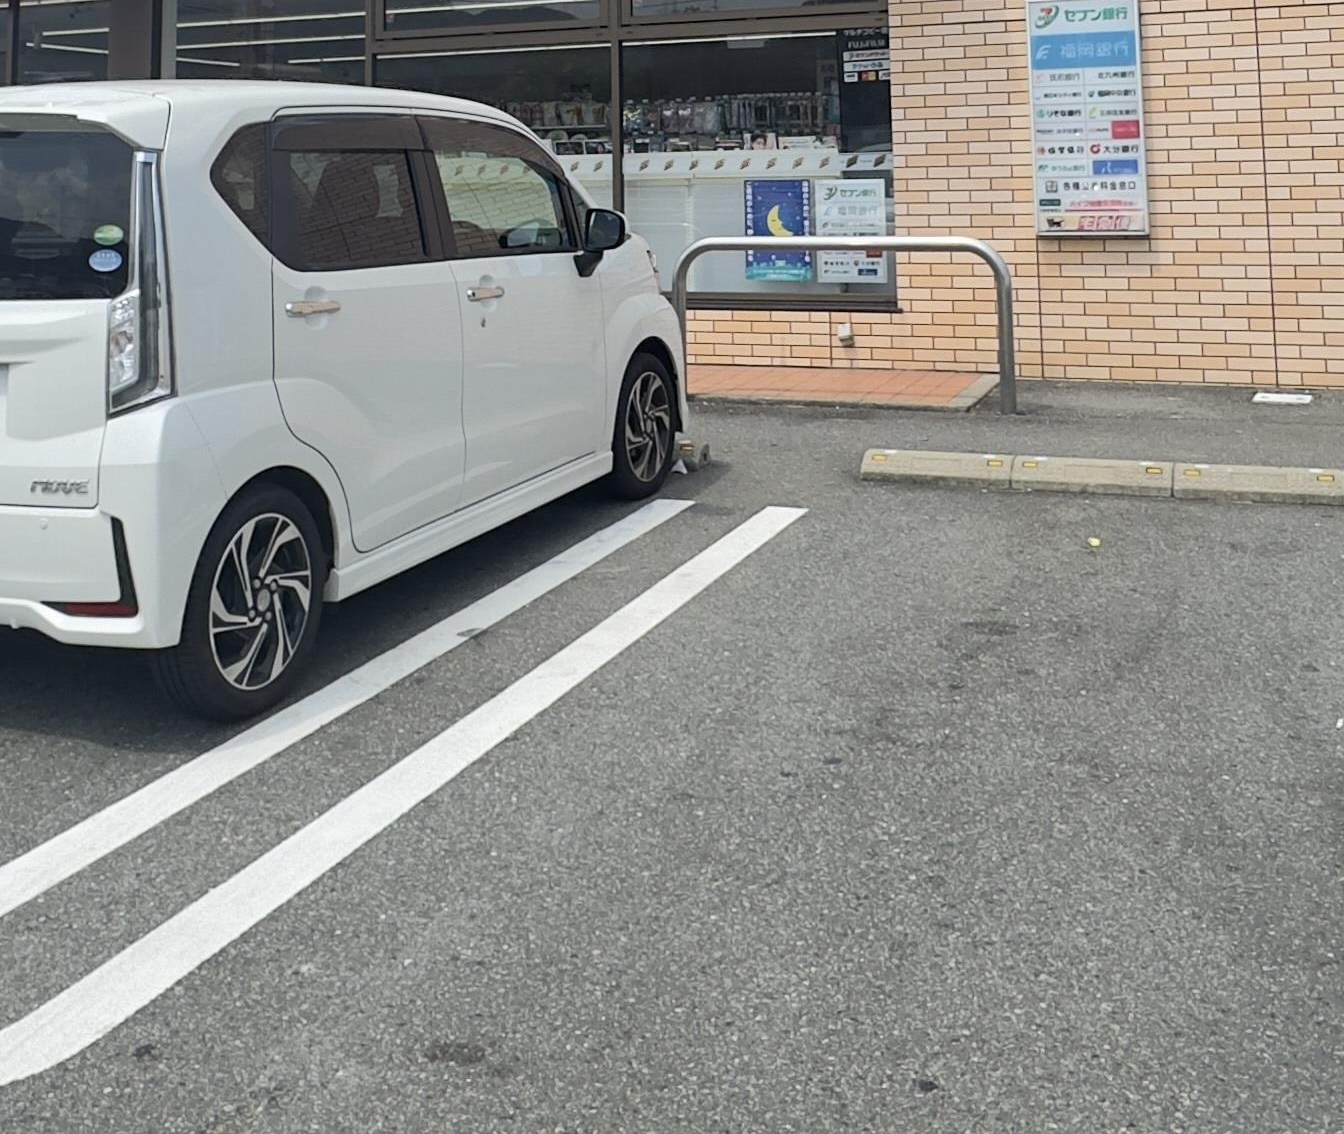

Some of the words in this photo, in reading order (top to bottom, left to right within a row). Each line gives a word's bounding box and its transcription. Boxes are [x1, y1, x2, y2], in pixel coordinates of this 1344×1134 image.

[1064, 6, 1128, 23] セブン銀行
[1060, 40, 1129, 59] 福岡銀行
